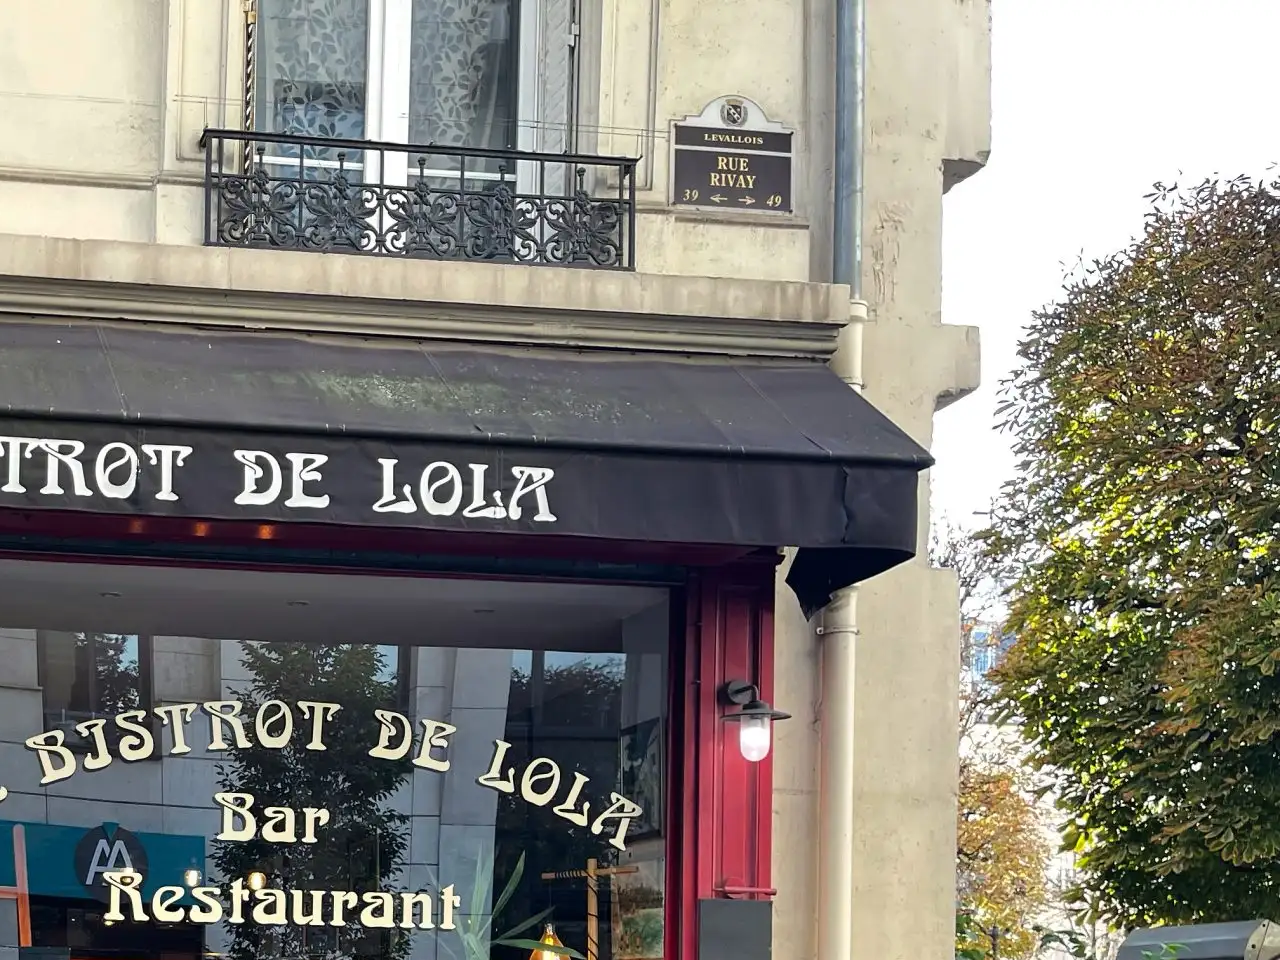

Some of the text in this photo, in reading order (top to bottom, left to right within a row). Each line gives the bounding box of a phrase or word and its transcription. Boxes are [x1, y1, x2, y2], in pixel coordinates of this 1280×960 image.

[704, 133, 764, 145] LEVALLOIS
[709, 172, 756, 189] RIVAY
[717, 156, 749, 171] RUE
[682, 188, 782, 207] 39 49
[233, 449, 330, 508] DE
[372, 457, 558, 522] LOLA
[26, 699, 342, 786] BISTROT
[368, 708, 457, 772] DE
[477, 739, 644, 852] LOLA
[214, 791, 331, 844] Bar
[102, 871, 461, 930] Restaurant
